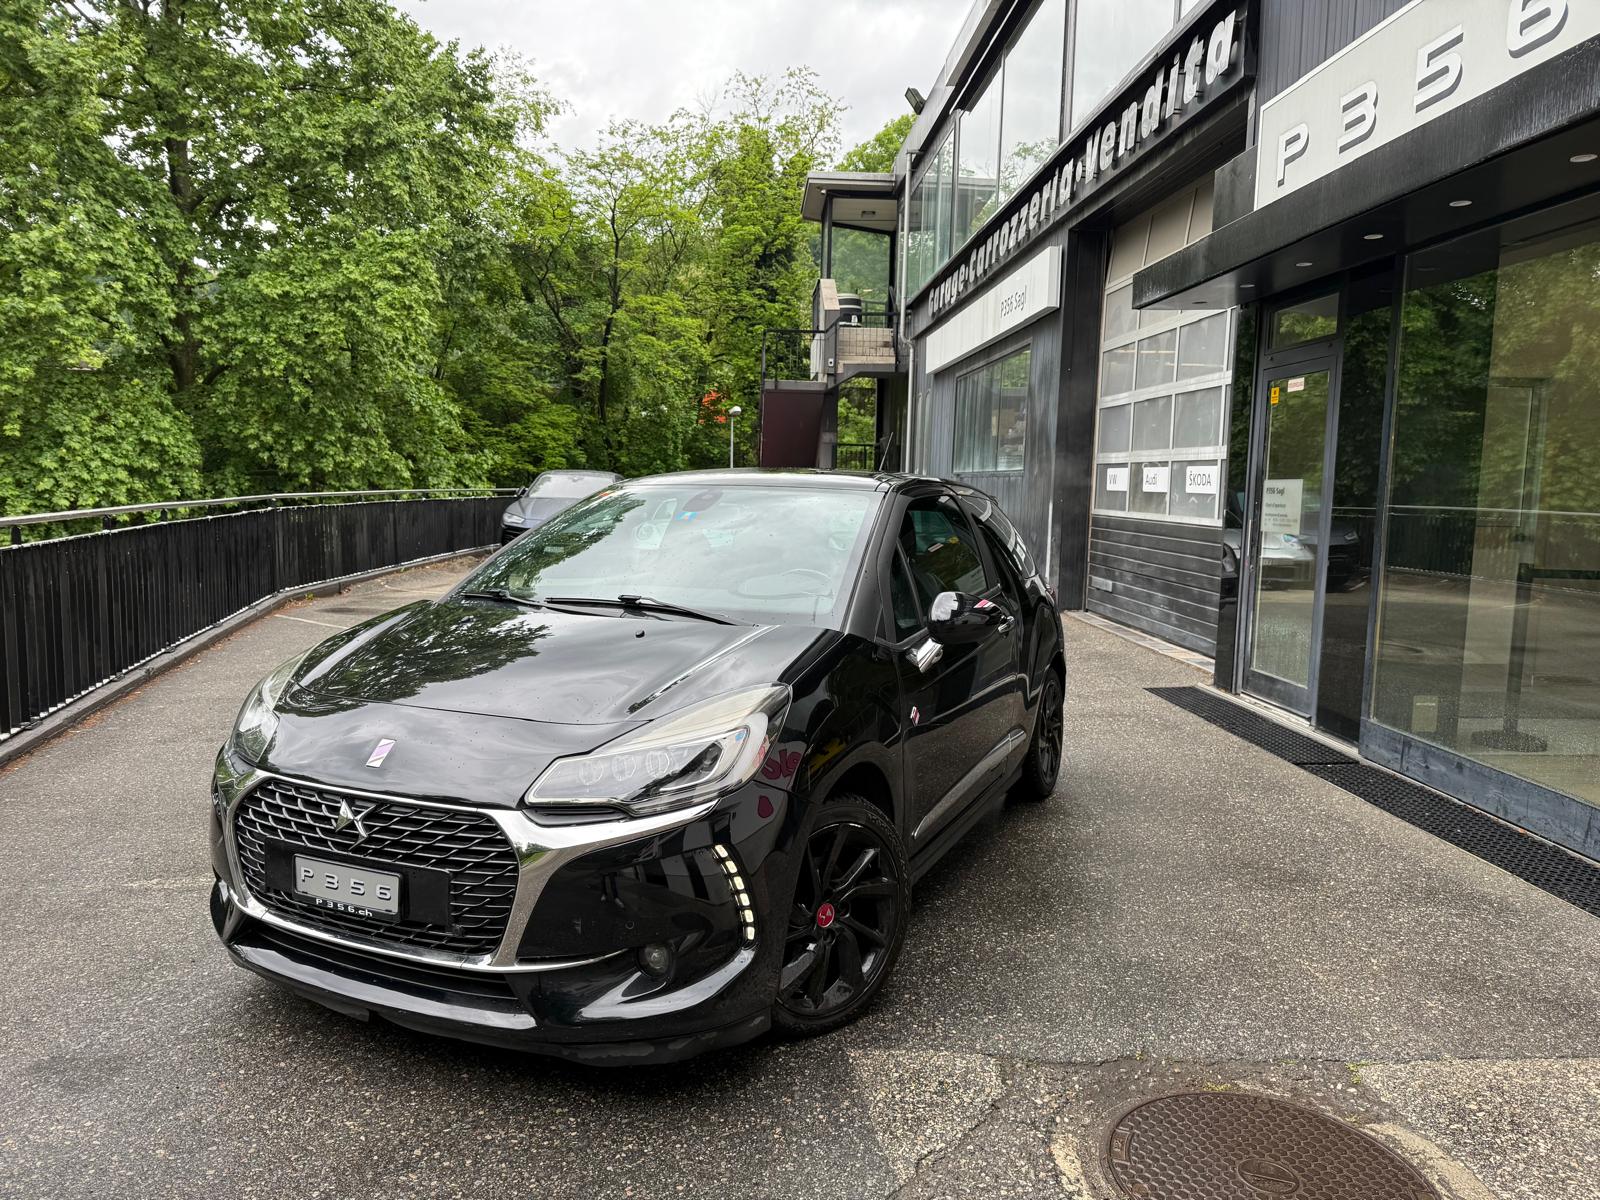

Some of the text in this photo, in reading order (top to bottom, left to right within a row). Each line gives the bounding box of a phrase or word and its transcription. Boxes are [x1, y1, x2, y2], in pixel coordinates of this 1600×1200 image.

[1109, 474, 1118, 485] VW
[1145, 473, 1158, 486] Audi
[1188, 471, 1212, 487] ŠKODA
